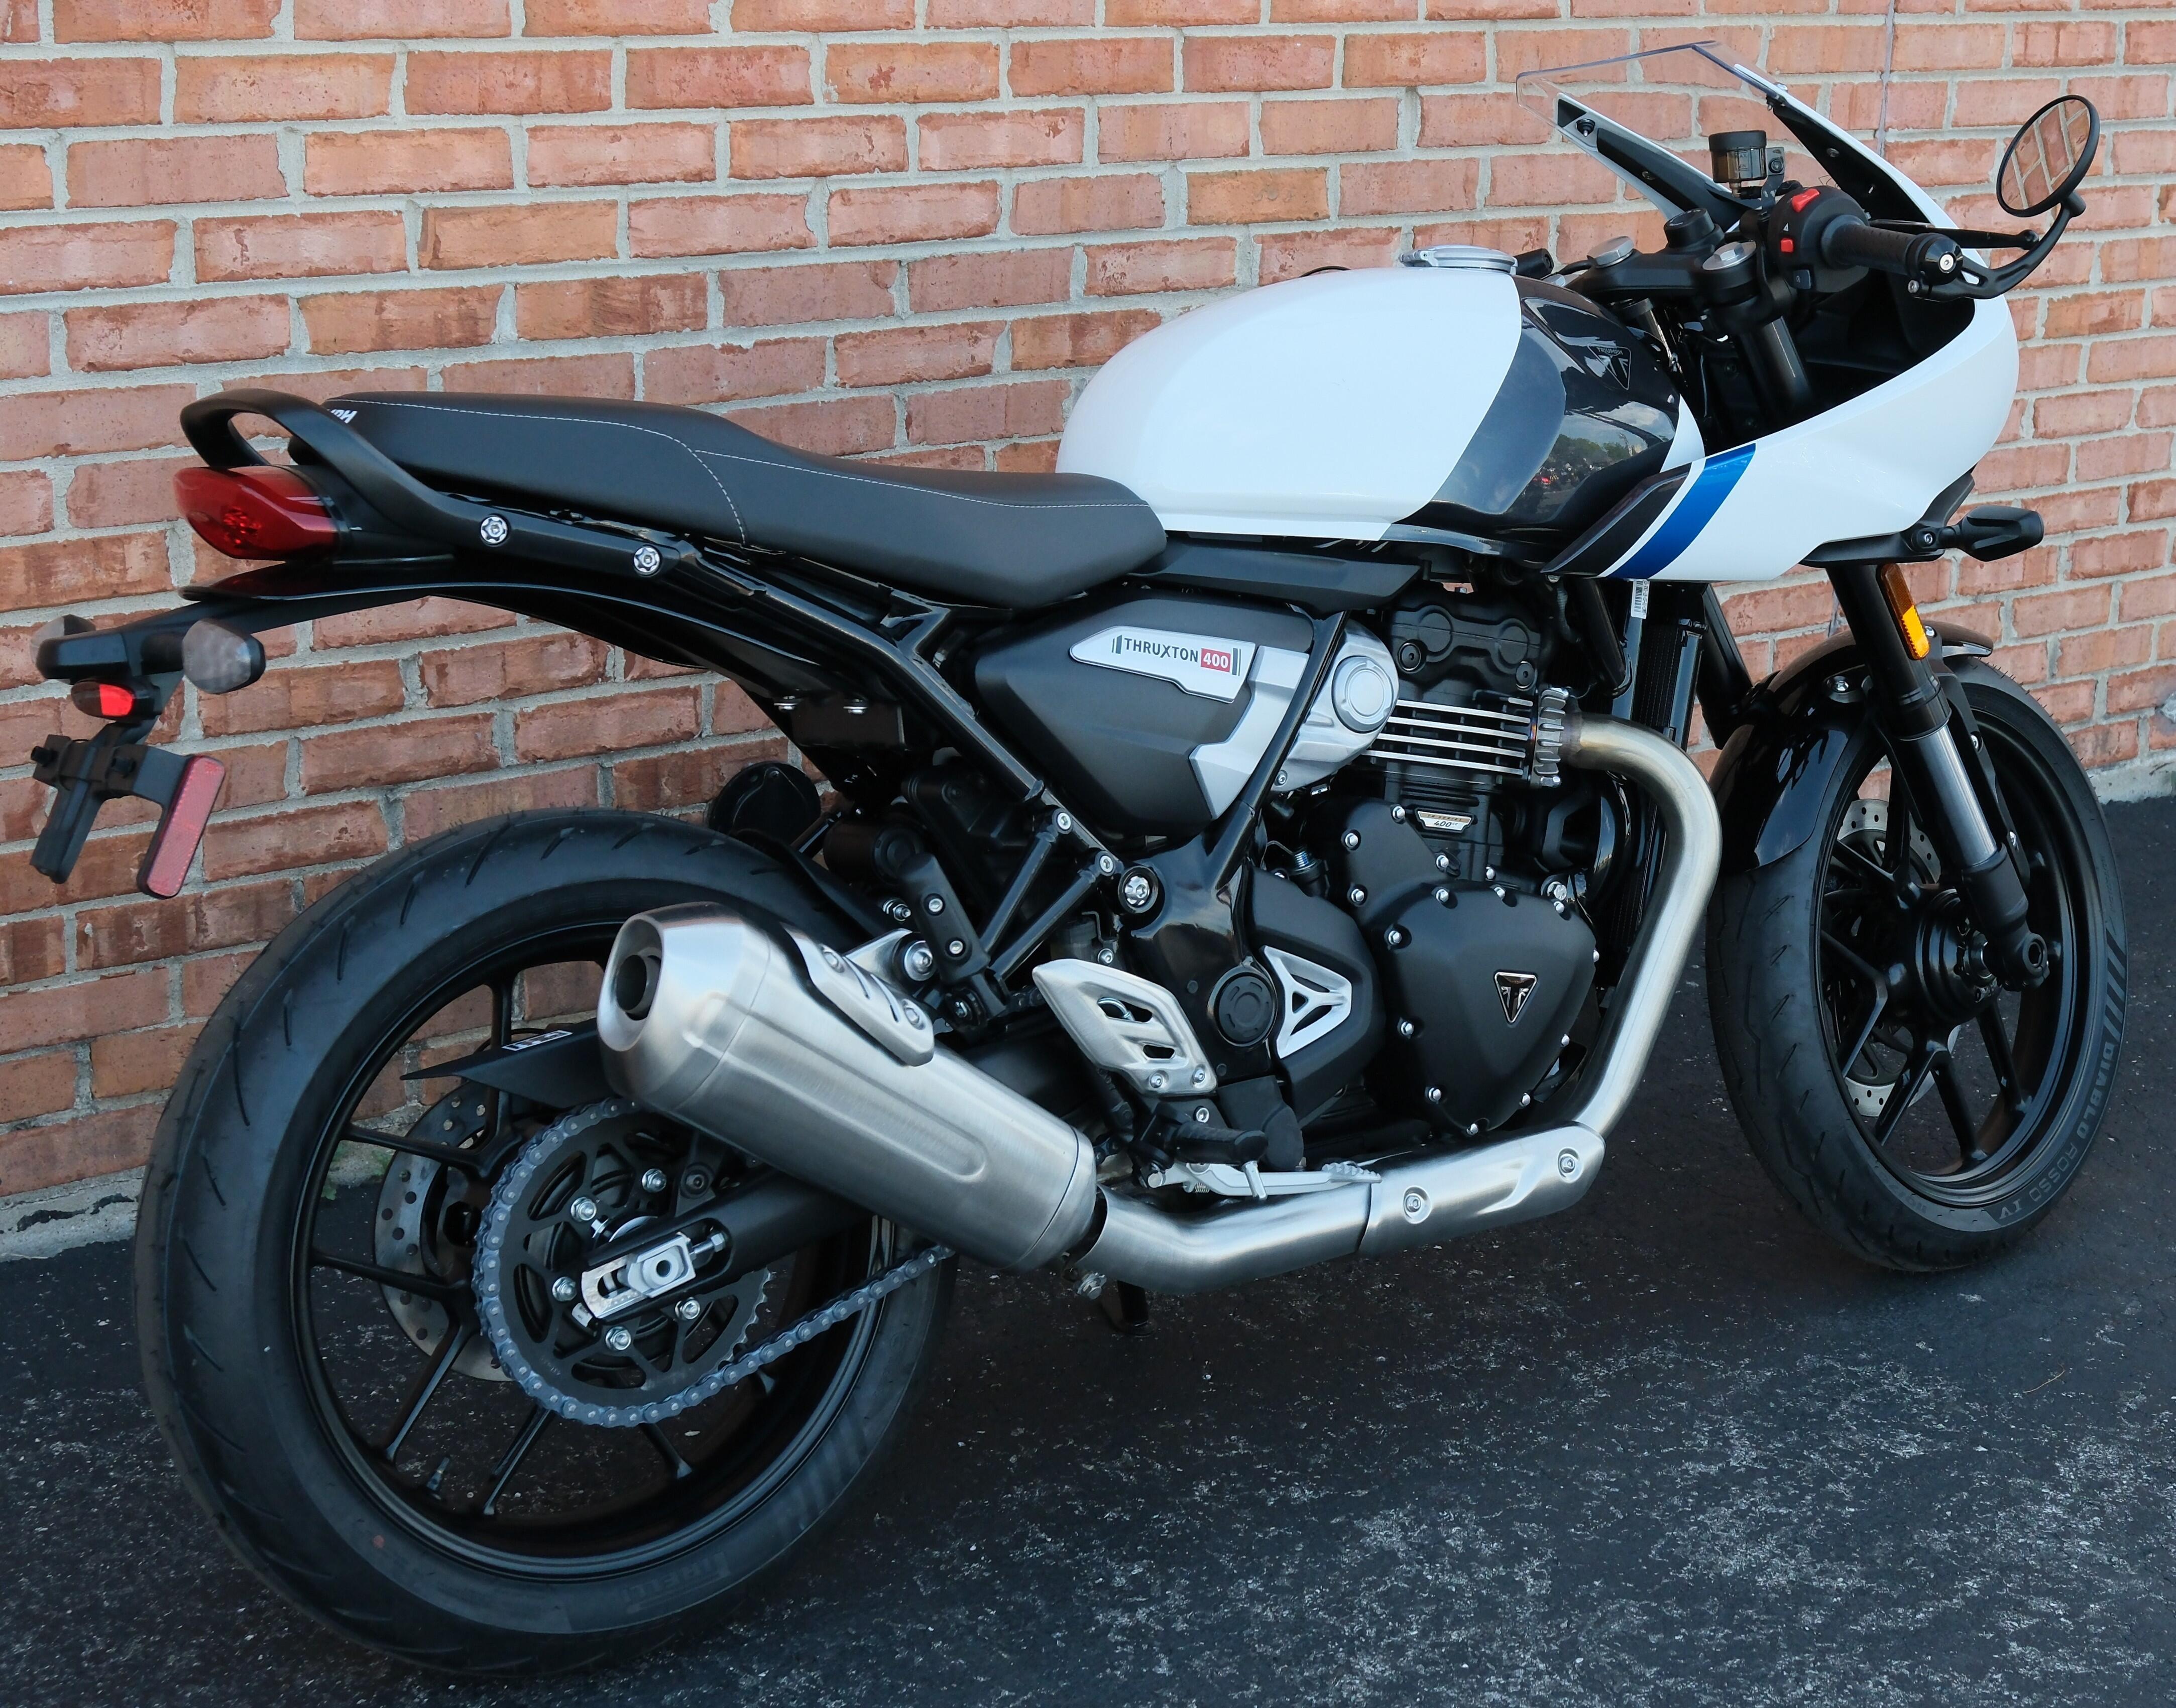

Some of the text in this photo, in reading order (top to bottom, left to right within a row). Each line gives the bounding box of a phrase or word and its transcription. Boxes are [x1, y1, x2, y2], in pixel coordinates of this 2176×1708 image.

[1124, 637, 1229, 669] THRUXTON 400
[1999, 1041, 2115, 1219] DIABLO ROSSO IV
